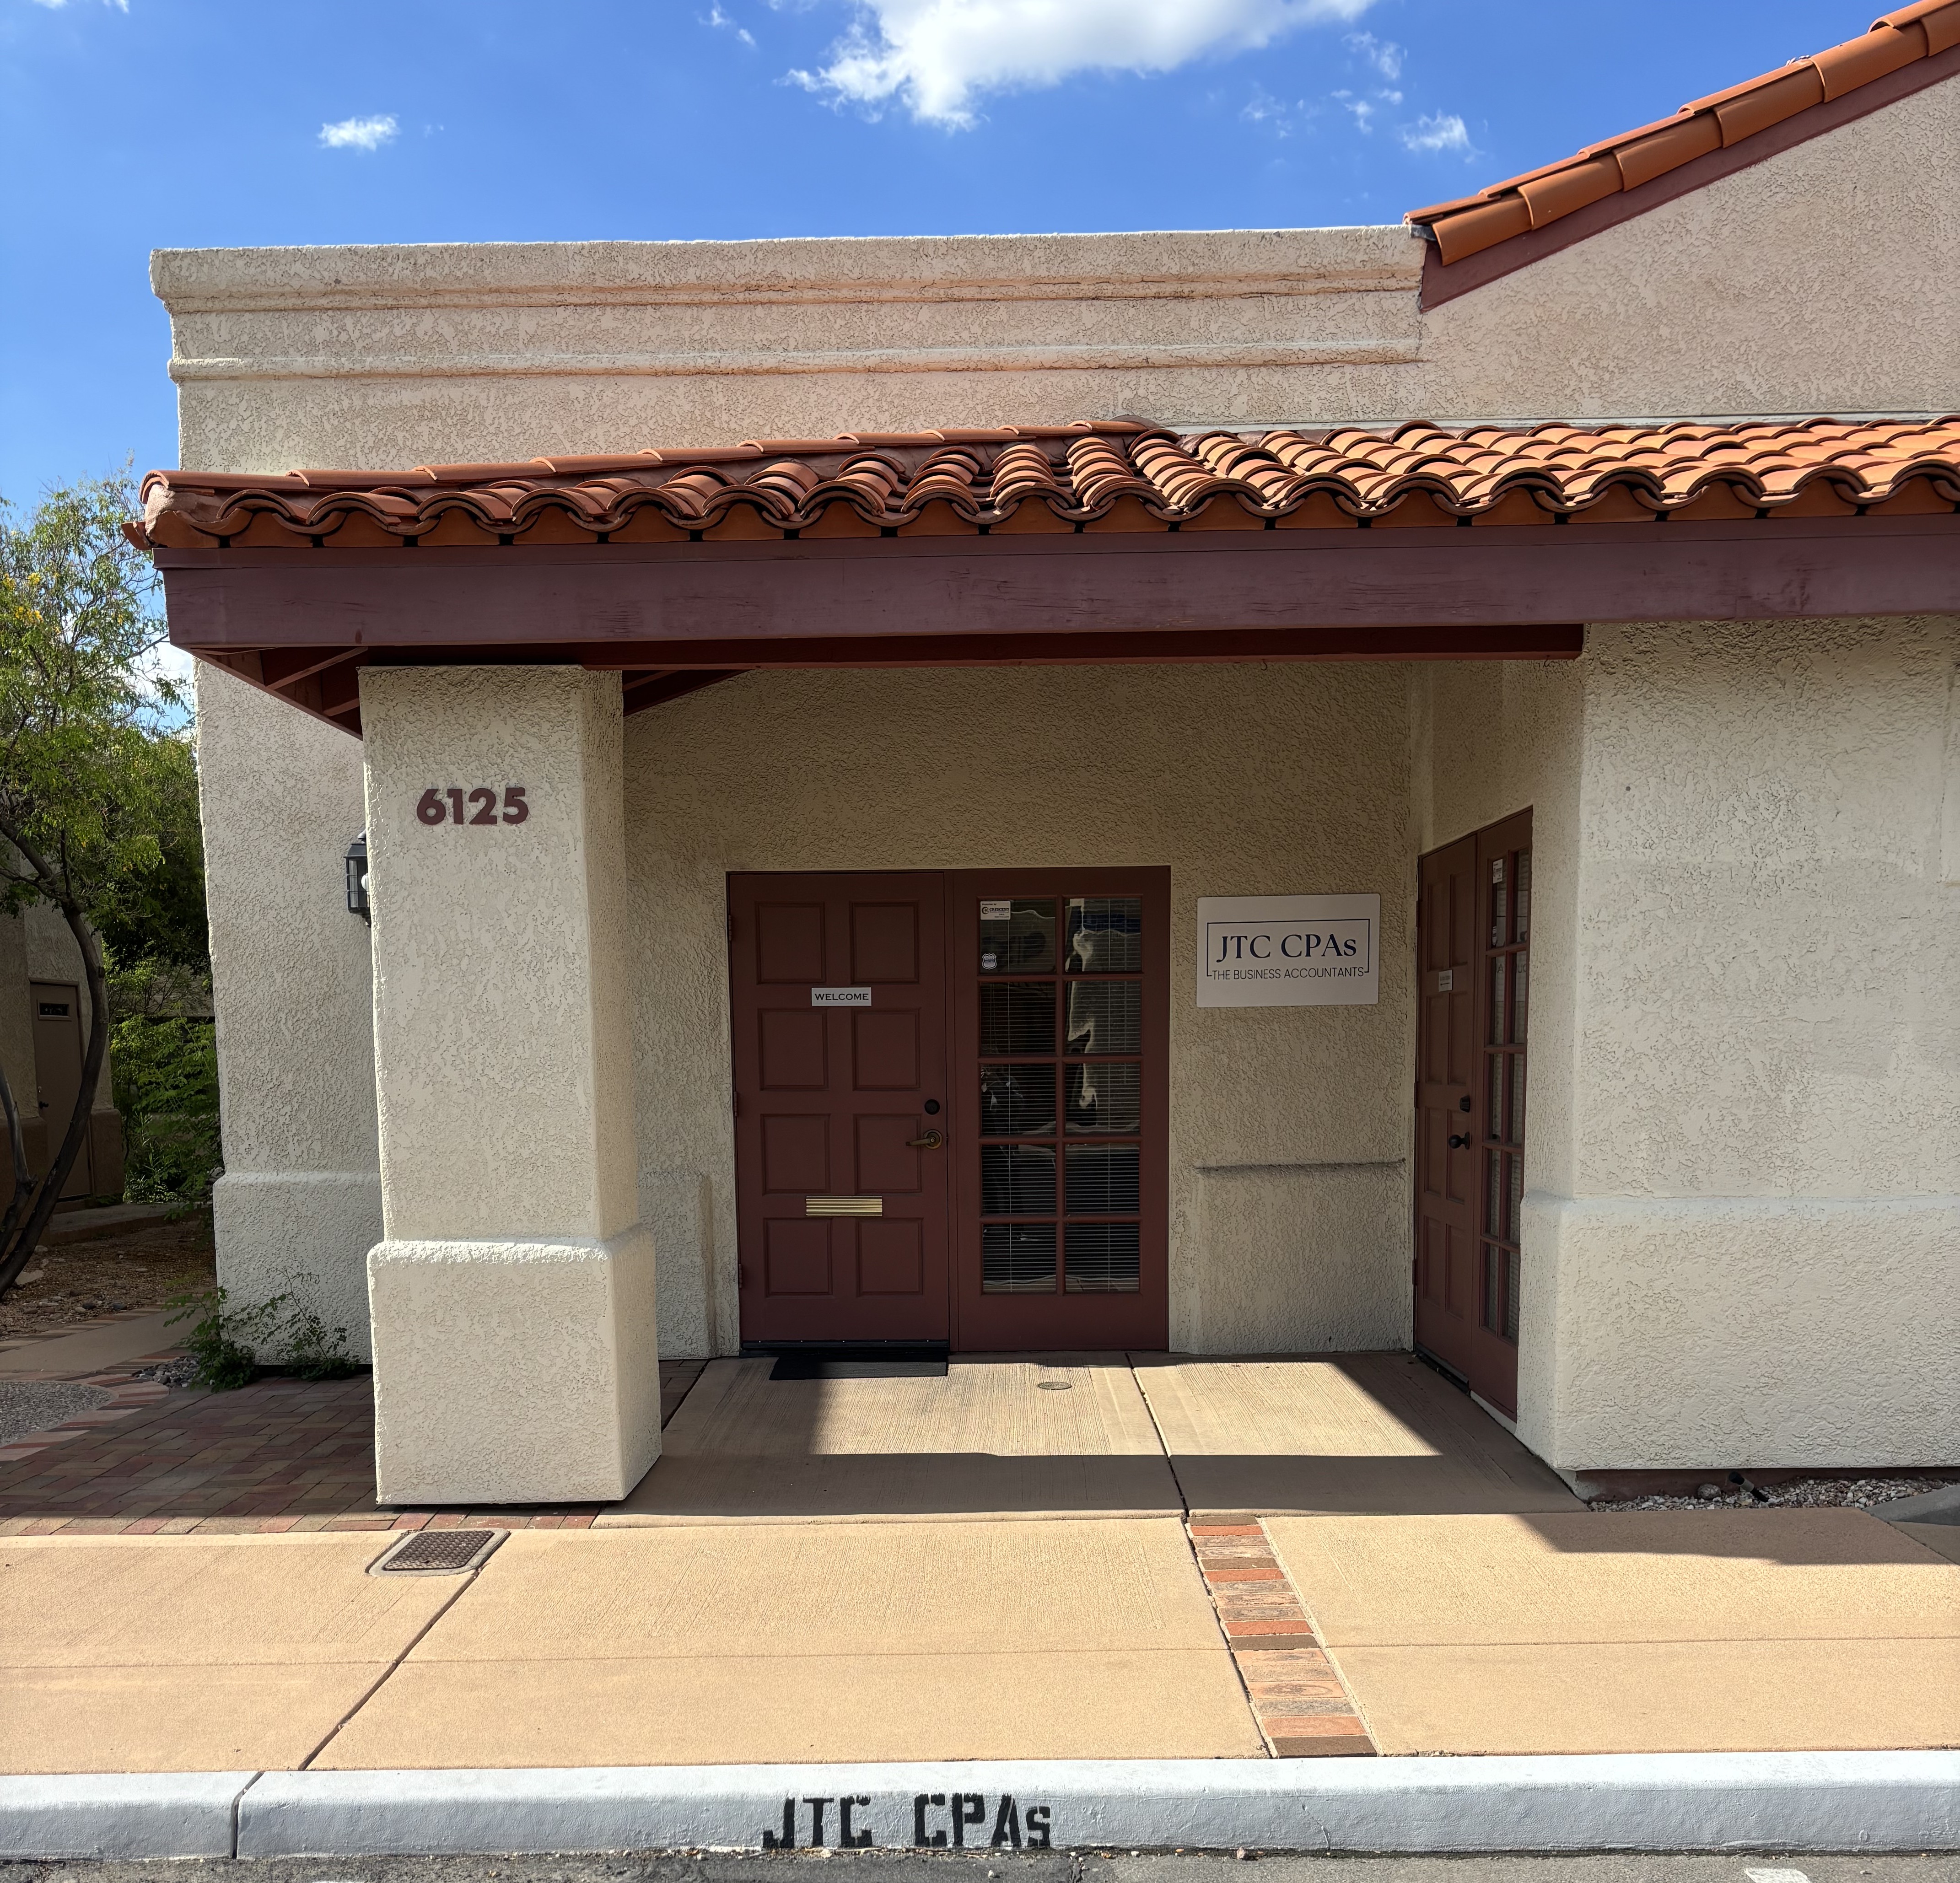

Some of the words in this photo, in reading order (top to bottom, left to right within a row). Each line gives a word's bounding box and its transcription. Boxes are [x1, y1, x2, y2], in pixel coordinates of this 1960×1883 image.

[416, 787, 529, 825] 6125
[1216, 935, 1271, 963] JTC
[1281, 933, 1357, 958] CPAs
[1212, 970, 1231, 980] THE
[1233, 968, 1282, 980] BUSINESS
[1284, 967, 1364, 979] ACCOUNTANTS
[762, 1793, 873, 1849] JTC
[915, 1792, 1051, 1847] CPAs
